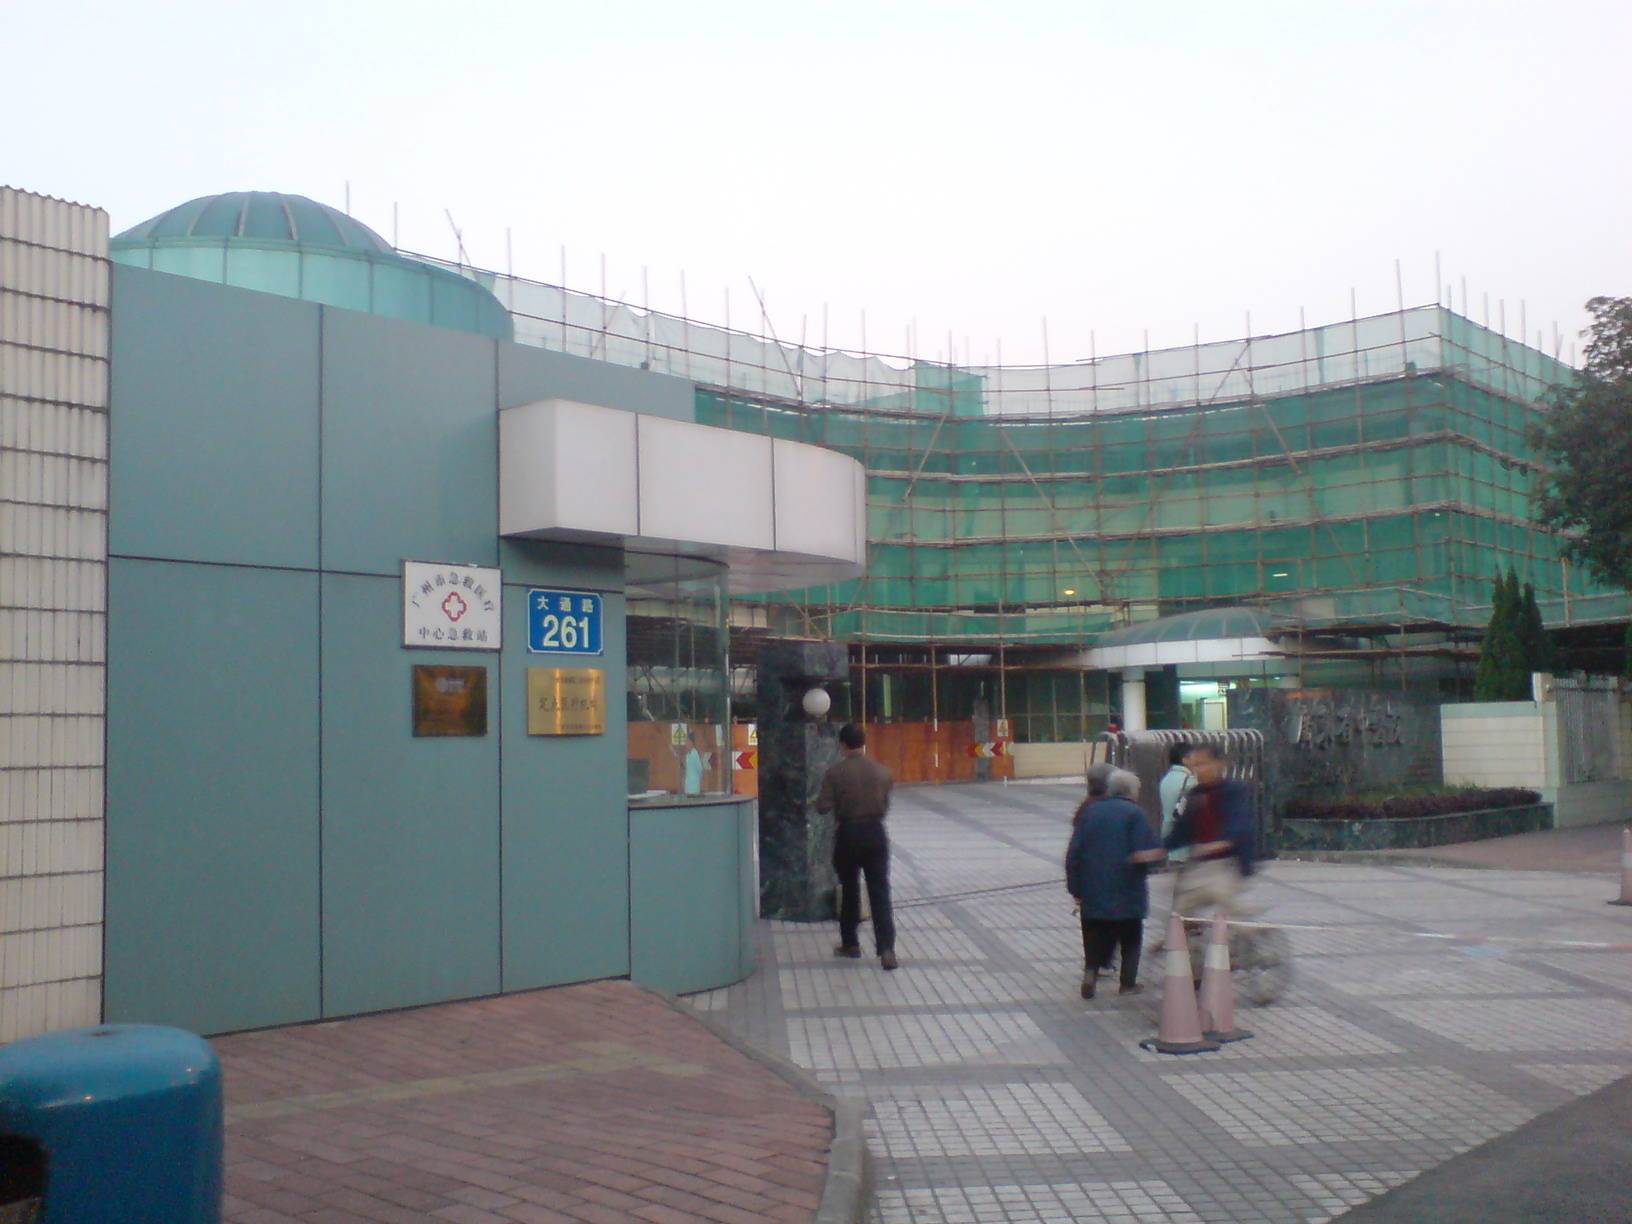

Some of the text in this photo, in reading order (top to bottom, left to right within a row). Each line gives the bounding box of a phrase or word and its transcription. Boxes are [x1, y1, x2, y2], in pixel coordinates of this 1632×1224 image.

[419, 627, 488, 642] 中心急救站
[543, 615, 589, 649] 261
